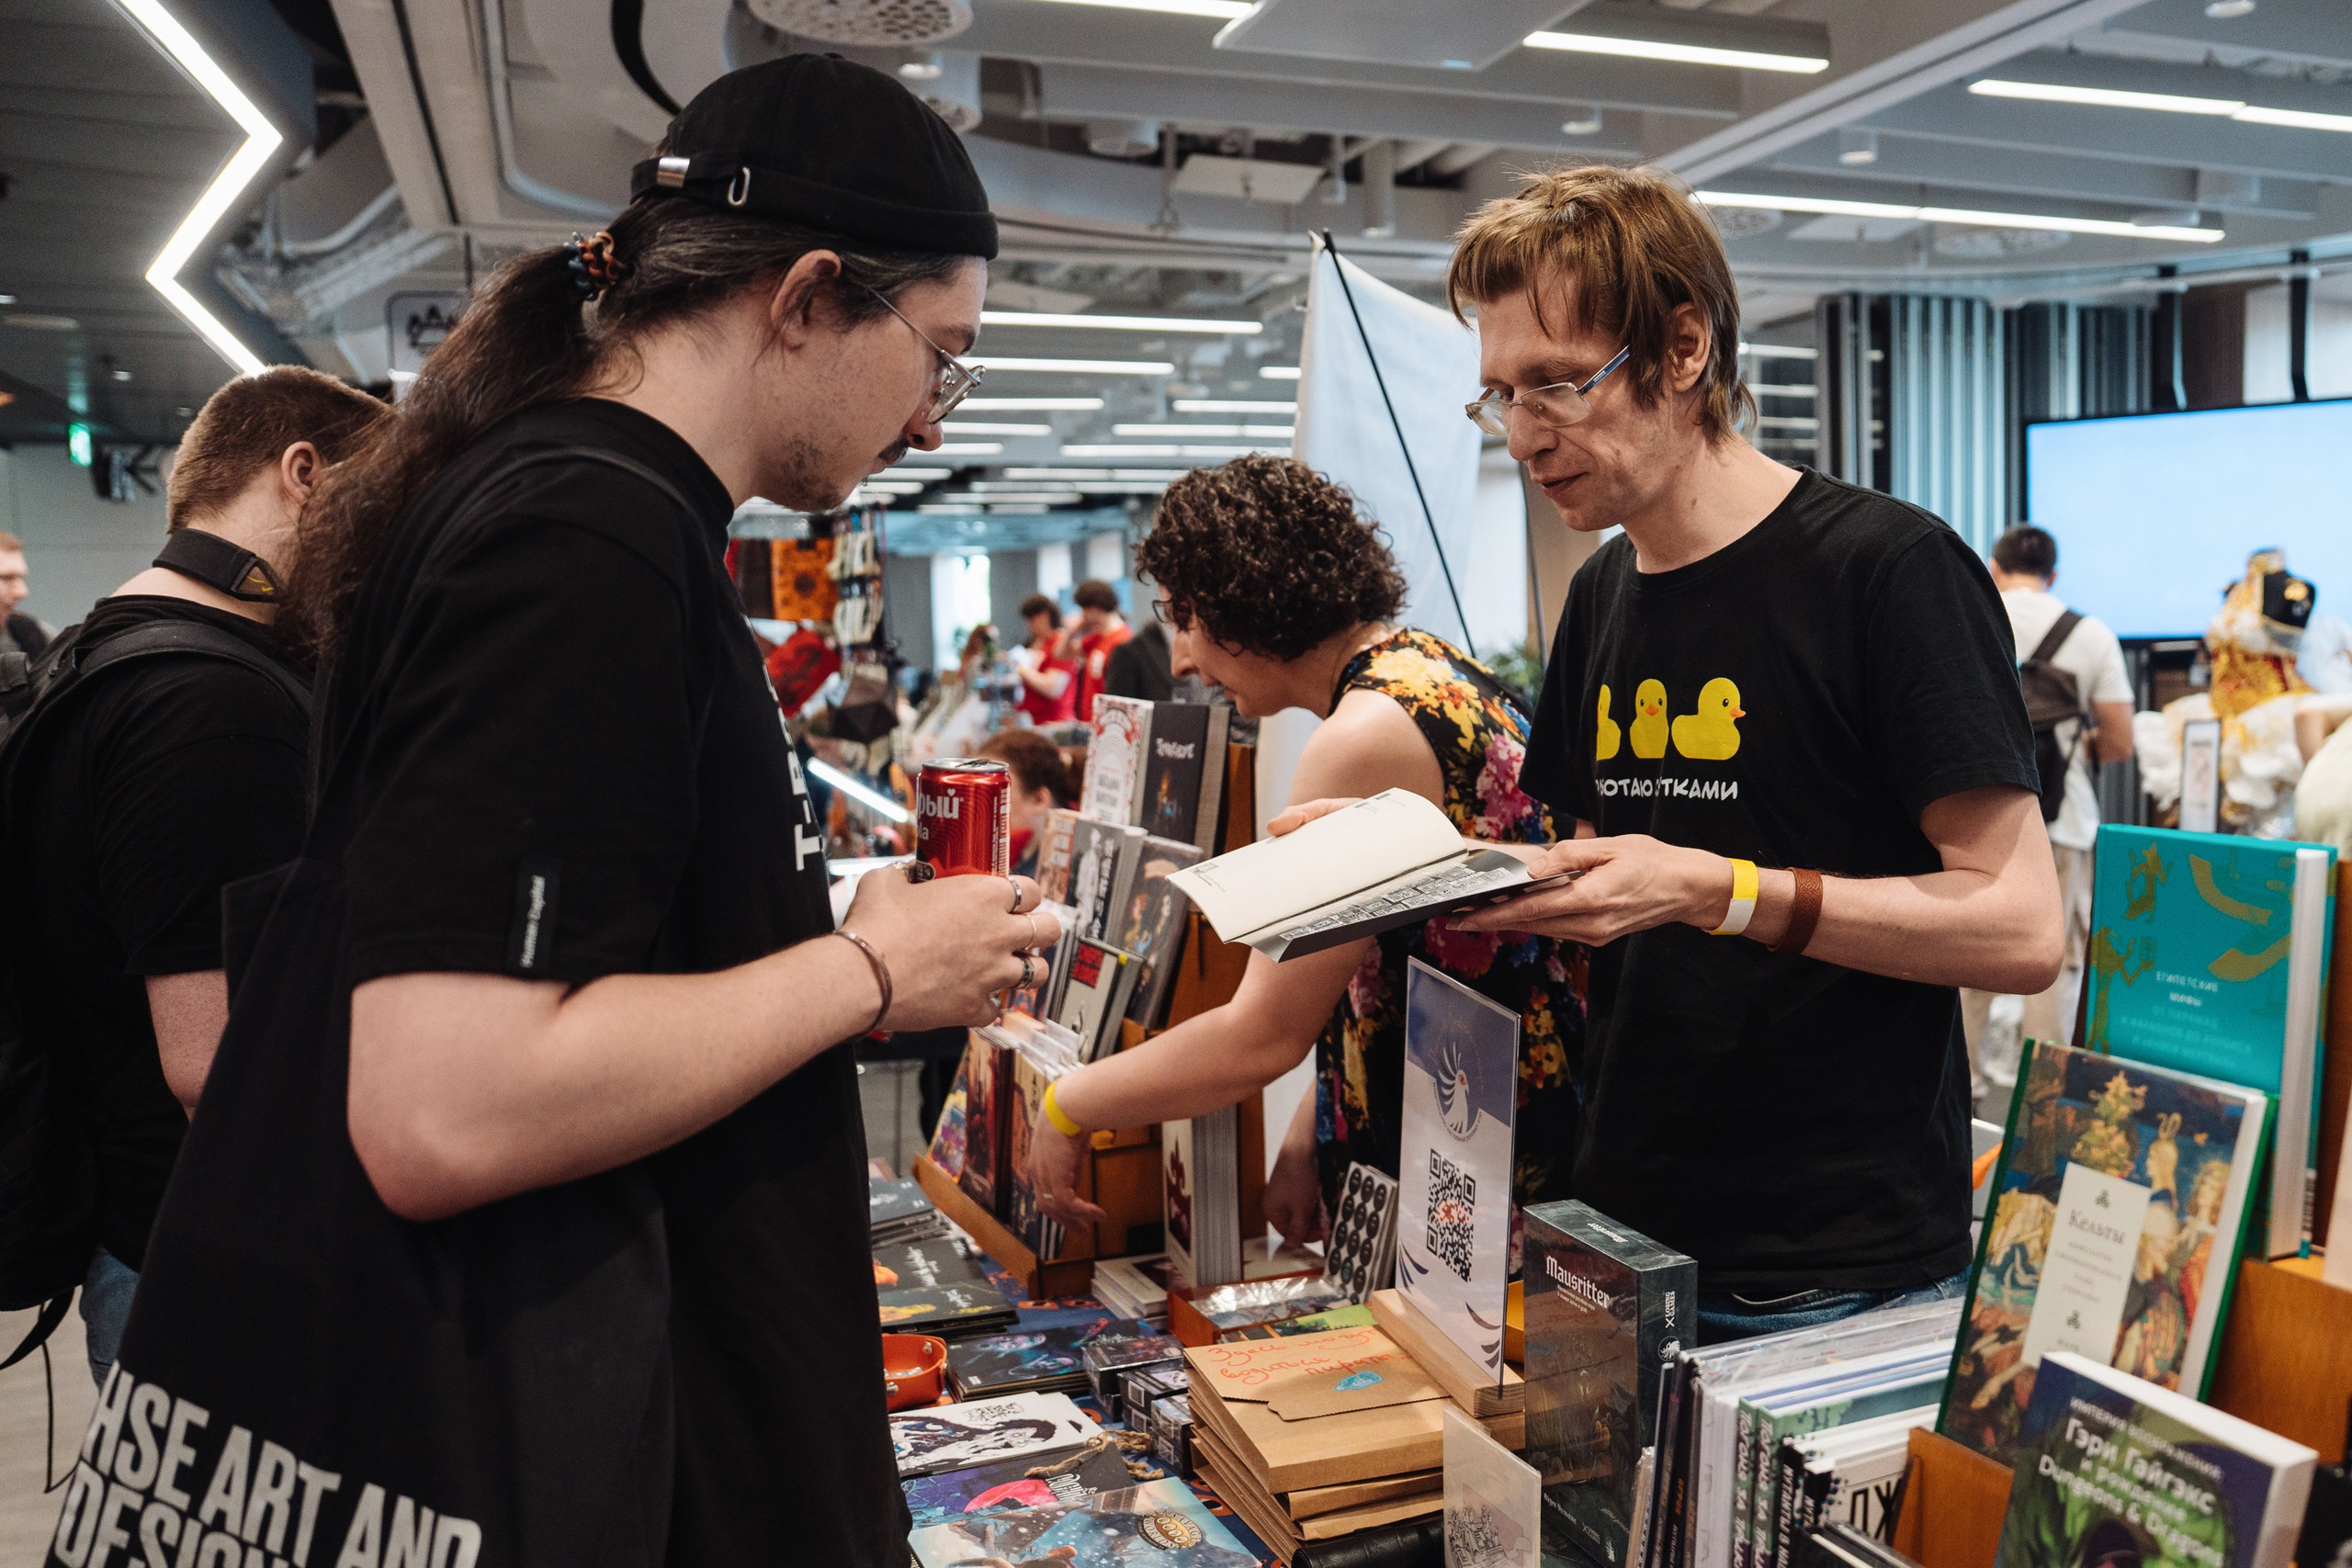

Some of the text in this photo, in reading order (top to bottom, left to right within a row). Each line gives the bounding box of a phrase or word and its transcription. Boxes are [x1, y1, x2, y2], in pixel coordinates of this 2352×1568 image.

[2068, 1208, 2126, 1244] Кельты
[1545, 1255, 1610, 1309] Mausritter
[1208, 1329, 1376, 1367] Здесь могут
[81, 1359, 210, 1512] HSE
[198, 1424, 343, 1566] ART
[2039, 1454, 2124, 1515] Dungeons
[2126, 1502, 2142, 1524] &
[2066, 1417, 2216, 1515] Гэри Гайгэкс
[52, 1461, 290, 1568] DES
[1780, 1463, 1794, 1533] МУТАНТЫ
[1779, 1532, 1791, 1545] В
